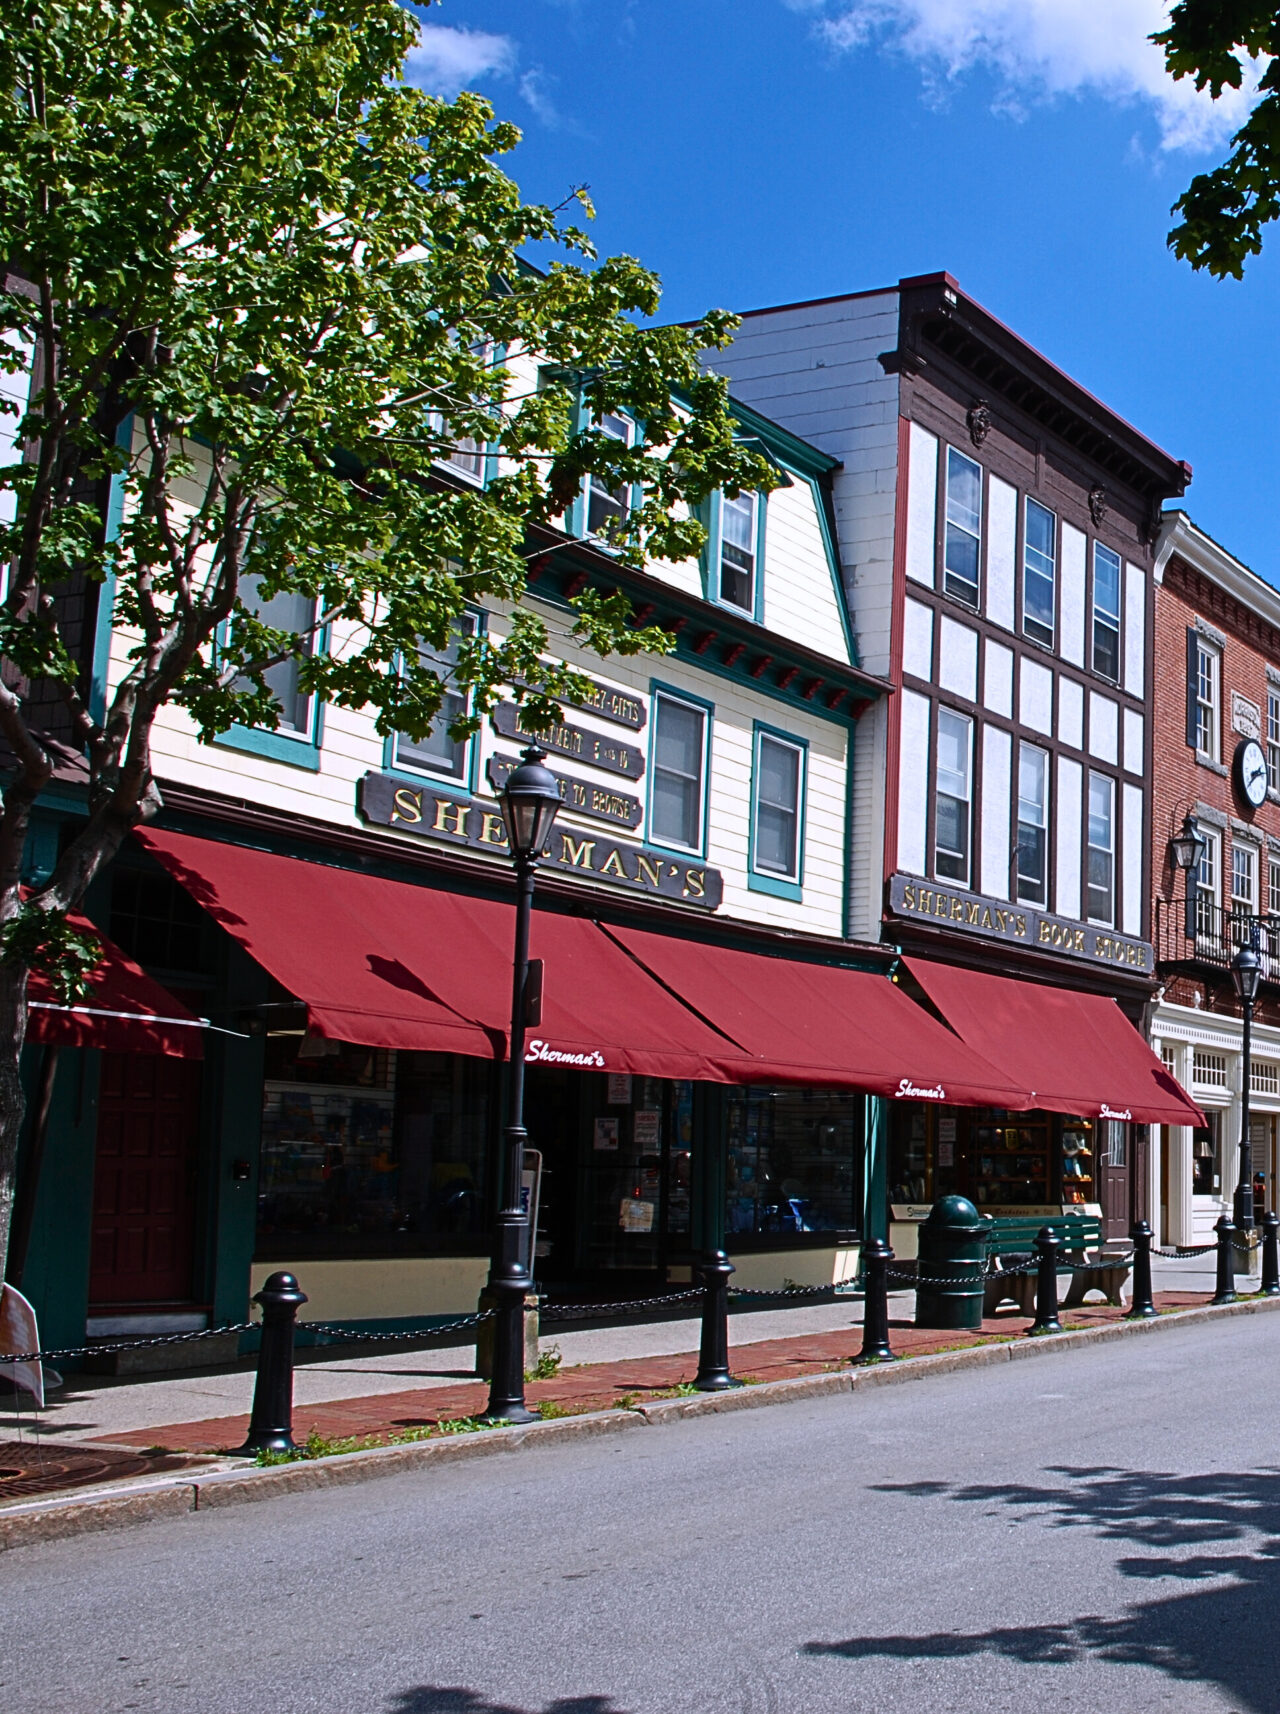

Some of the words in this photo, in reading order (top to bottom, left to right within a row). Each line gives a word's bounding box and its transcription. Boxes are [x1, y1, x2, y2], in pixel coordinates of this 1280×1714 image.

[573, 783, 587, 807] TO
[390, 788, 705, 898] SHEMAN'S
[902, 884, 1028, 937] SHERMAN'S
[1038, 921, 1085, 952] BOOK
[1095, 939, 1147, 967] STORE
[524, 1040, 605, 1067] Sherman's
[894, 1079, 945, 1099] Sherman's
[1099, 1103, 1132, 1120] Sherman's
